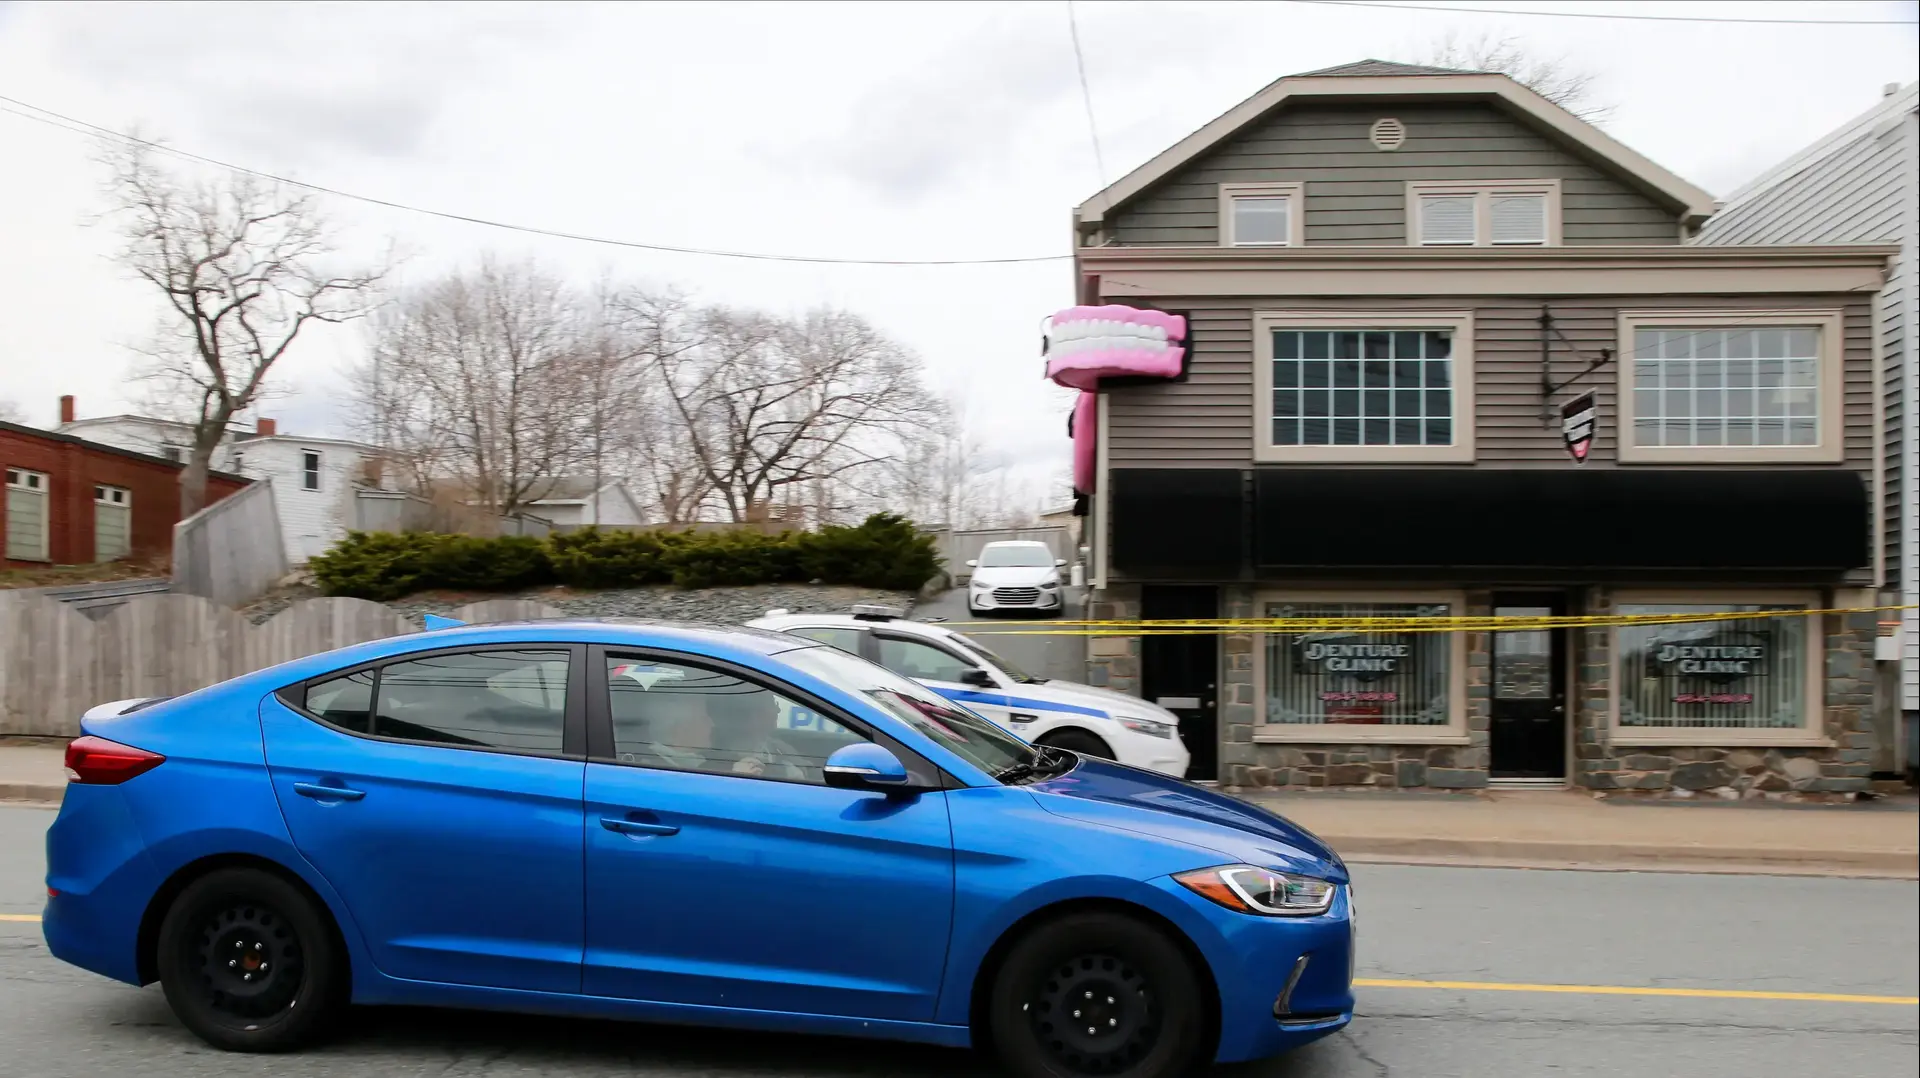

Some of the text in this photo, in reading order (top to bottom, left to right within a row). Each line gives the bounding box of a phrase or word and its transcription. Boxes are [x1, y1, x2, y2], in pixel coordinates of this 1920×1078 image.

[1304, 643, 1409, 660] DENTURE
[1657, 645, 1763, 661] DENTURE
[1325, 658, 1397, 671] CLINIC
[1679, 660, 1750, 673] CLINIC
